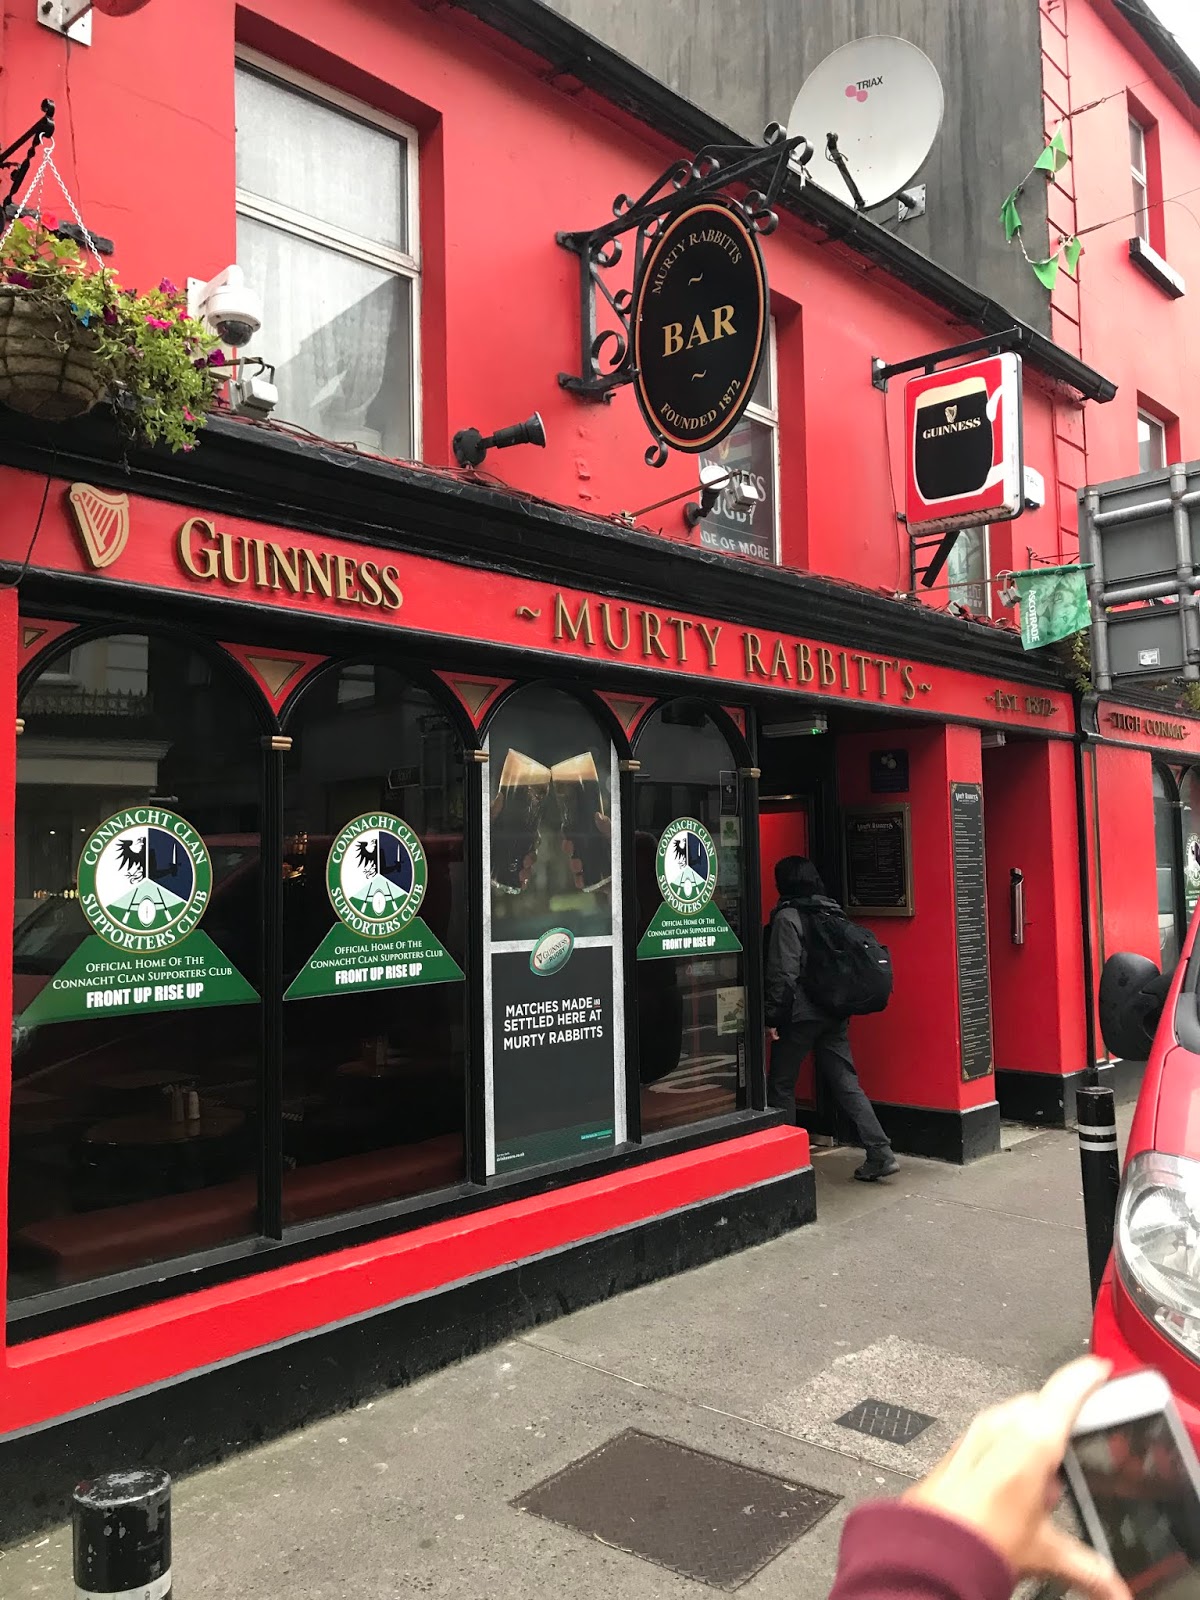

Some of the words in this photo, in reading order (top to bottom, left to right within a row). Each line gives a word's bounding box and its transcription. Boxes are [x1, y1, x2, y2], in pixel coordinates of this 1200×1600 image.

[856, 75, 883, 90] TRIAX
[652, 239, 686, 294] MURTY
[689, 229, 742, 265] RABBITTS
[662, 304, 738, 358] BAR
[660, 402, 717, 430] FOUNDED
[718, 379, 741, 411] 1872
[922, 417, 982, 440] GUINNESS
[177, 516, 405, 611] GUINNESS
[720, 536, 736, 551] OF
[739, 540, 770, 560] MORE
[1028, 589, 1040, 643] ASCOTRADE
[552, 592, 723, 669] MURTY
[741, 632, 917, 701] RABBITT'S
[84, 810, 172, 865] CONNACHT
[174, 822, 207, 865] CLAN
[332, 815, 397, 864] CONNACHT
[399, 825, 423, 863] CLAN
[658, 820, 698, 857] CONNACHT
[698, 826, 715, 857] CLAN
[331, 887, 401, 936] SUPPORTERS
[401, 883, 424, 922] CLUB
[658, 875, 702, 913] SUPPORTERS
[701, 873, 716, 904] CLUB
[82, 893, 176, 950] SUPPORTERS
[177, 890, 207, 934] CLUB
[662, 938, 682, 950] FRONT
[683, 937, 692, 948] UP
[693, 936, 706, 947] RISE
[707, 936, 716, 947] UP
[52, 975, 115, 990] CONNACHT
[117, 973, 145, 984] CLAN
[147, 969, 207, 982] SUPPORTERS
[208, 967, 233, 976] CLUB
[86, 962, 132, 973] OFFICIAL
[135, 958, 167, 969] HOME
[168, 957, 182, 967] OF
[185, 956, 205, 965] THE
[335, 968, 369, 985] FRONT
[370, 966, 384, 981] UP
[385, 964, 408, 979] RISE
[409, 962, 423, 977] UP
[86, 988, 132, 1009] FRONT
[133, 986, 152, 1004] UP
[154, 983, 184, 1002] RISE
[186, 982, 204, 999] UP
[506, 1000, 559, 1017] MATCHES
[562, 997, 593, 1011] MADE
[503, 1033, 545, 1050] MURTY
[549, 1026, 603, 1044] RABBITTS
[504, 1015, 554, 1032] SETTLED
[558, 1011, 586, 1025] HERE
[589, 1009, 602, 1021] AT
